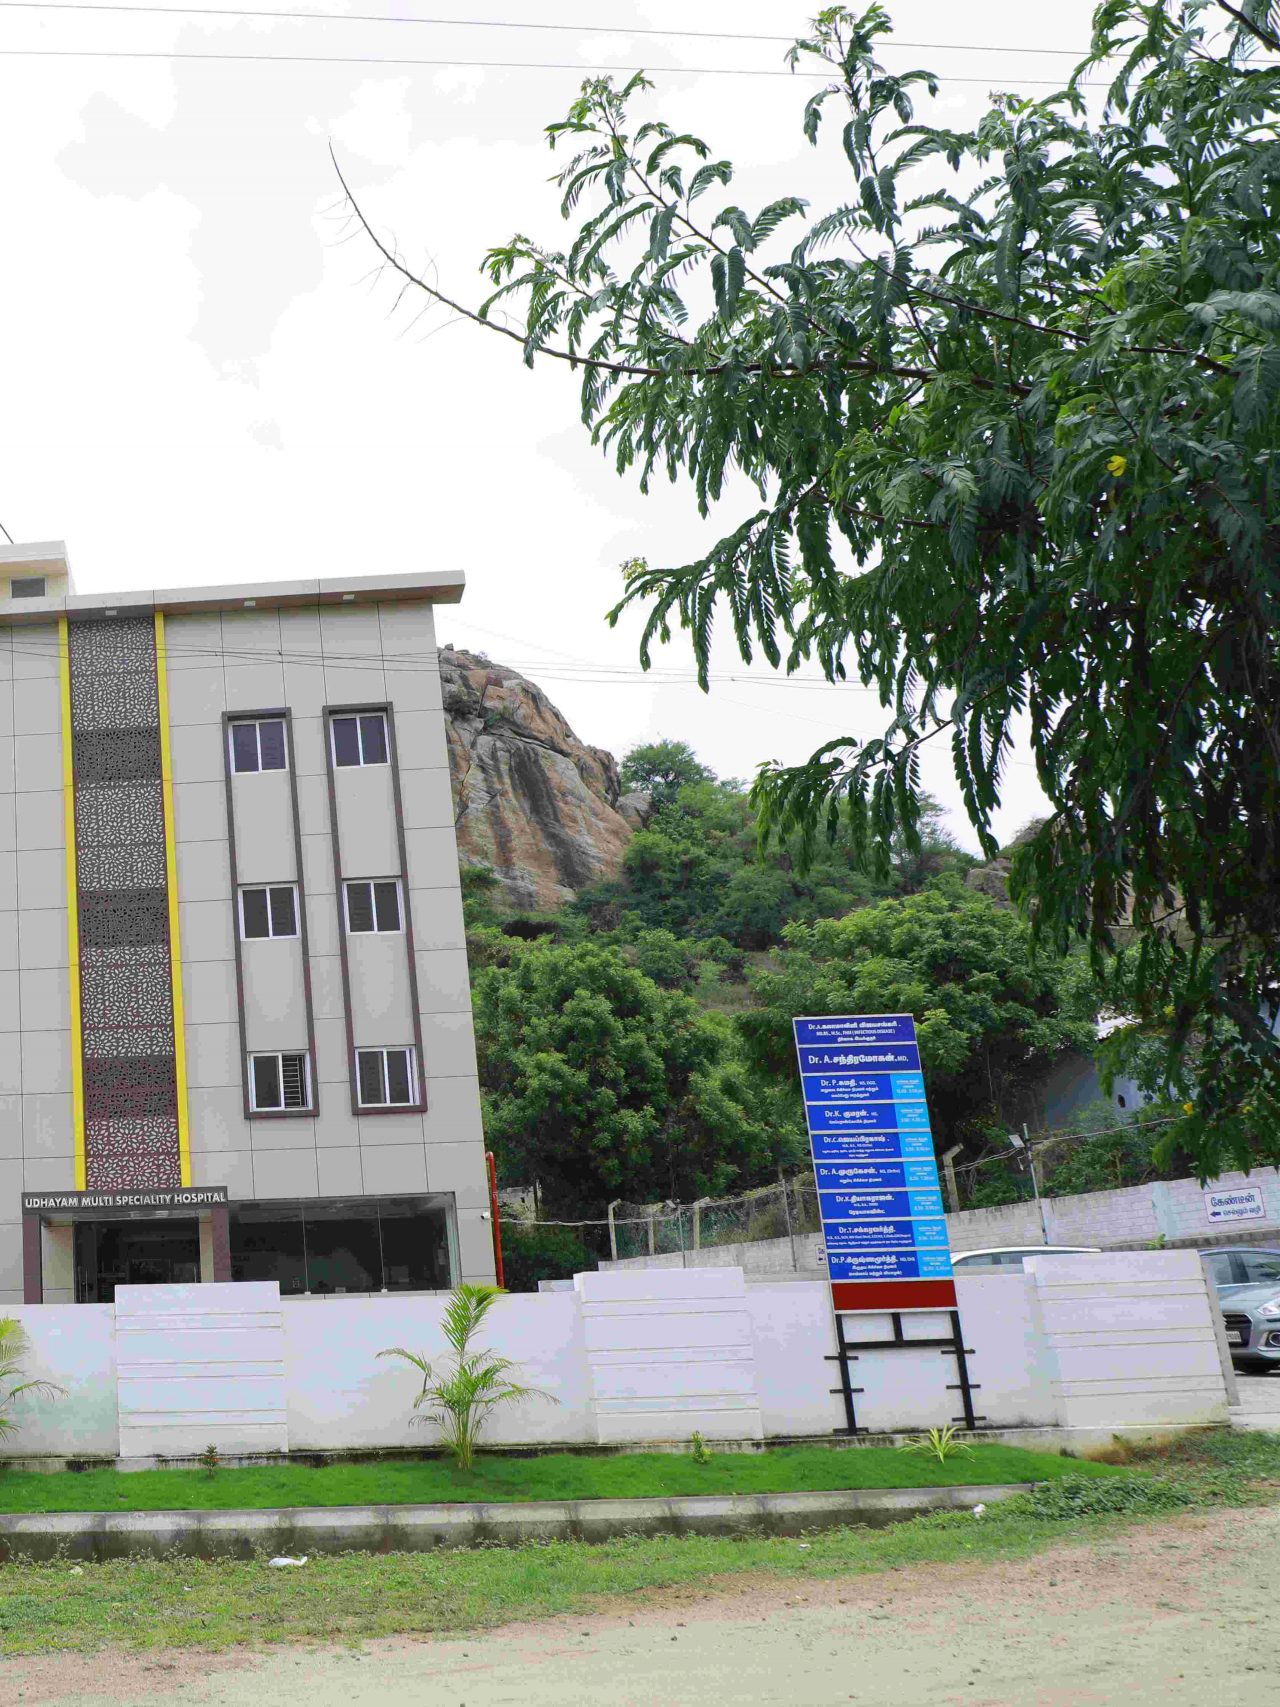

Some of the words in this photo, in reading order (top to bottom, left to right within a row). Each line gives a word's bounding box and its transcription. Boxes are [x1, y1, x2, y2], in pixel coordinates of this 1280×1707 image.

[25, 1197, 78, 1208] UDHAYAM
[81, 1196, 113, 1207] MULTI
[116, 1194, 172, 1206] SPECIALITY
[174, 1192, 225, 1204] HOSPITAL
